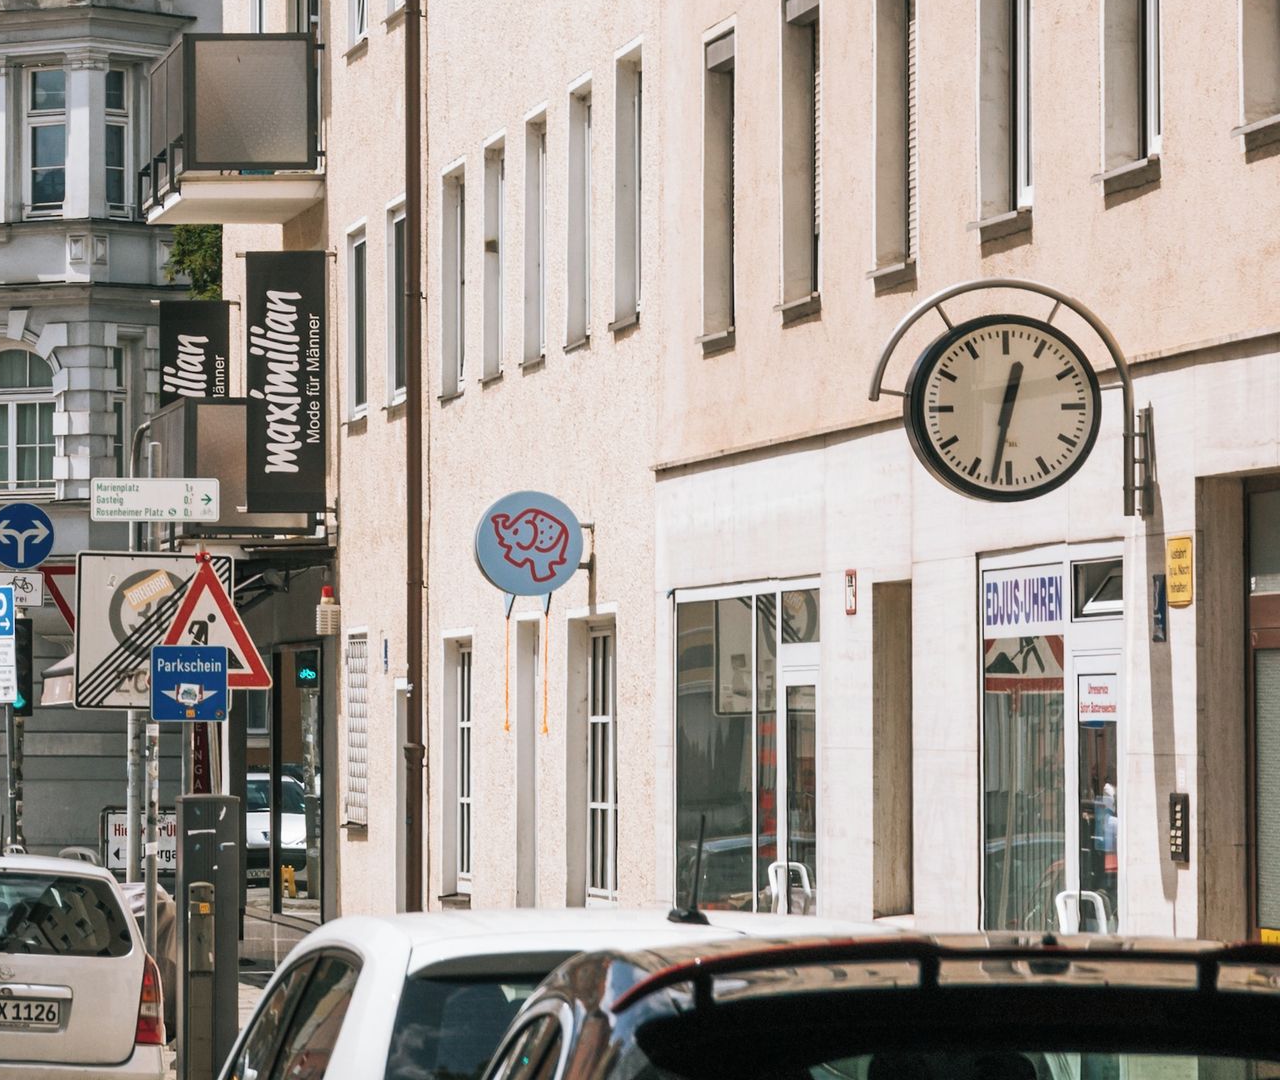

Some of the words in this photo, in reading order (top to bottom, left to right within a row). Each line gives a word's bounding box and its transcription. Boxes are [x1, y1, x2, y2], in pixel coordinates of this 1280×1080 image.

[306, 313, 320, 371] Männer
[163, 334, 210, 398] ilian
[213, 355, 225, 397] änner
[250, 289, 302, 474] maximilian
[306, 376, 320, 396] für
[306, 401, 320, 443] Mode
[96, 483, 139, 494] Marienplatz
[96, 495, 124, 505] Gasteig
[96, 507, 142, 517] Rosenheimer
[144, 507, 163, 517] Platz
[15, 595, 27, 603] rei
[986, 575, 1063, 626] EDJUS-UHREN
[157, 658, 222, 673] Parkschein
[194, 722, 203, 789] EINGA
[114, 824, 128, 837] Hie
[12, 1003, 56, 1022] 1126
